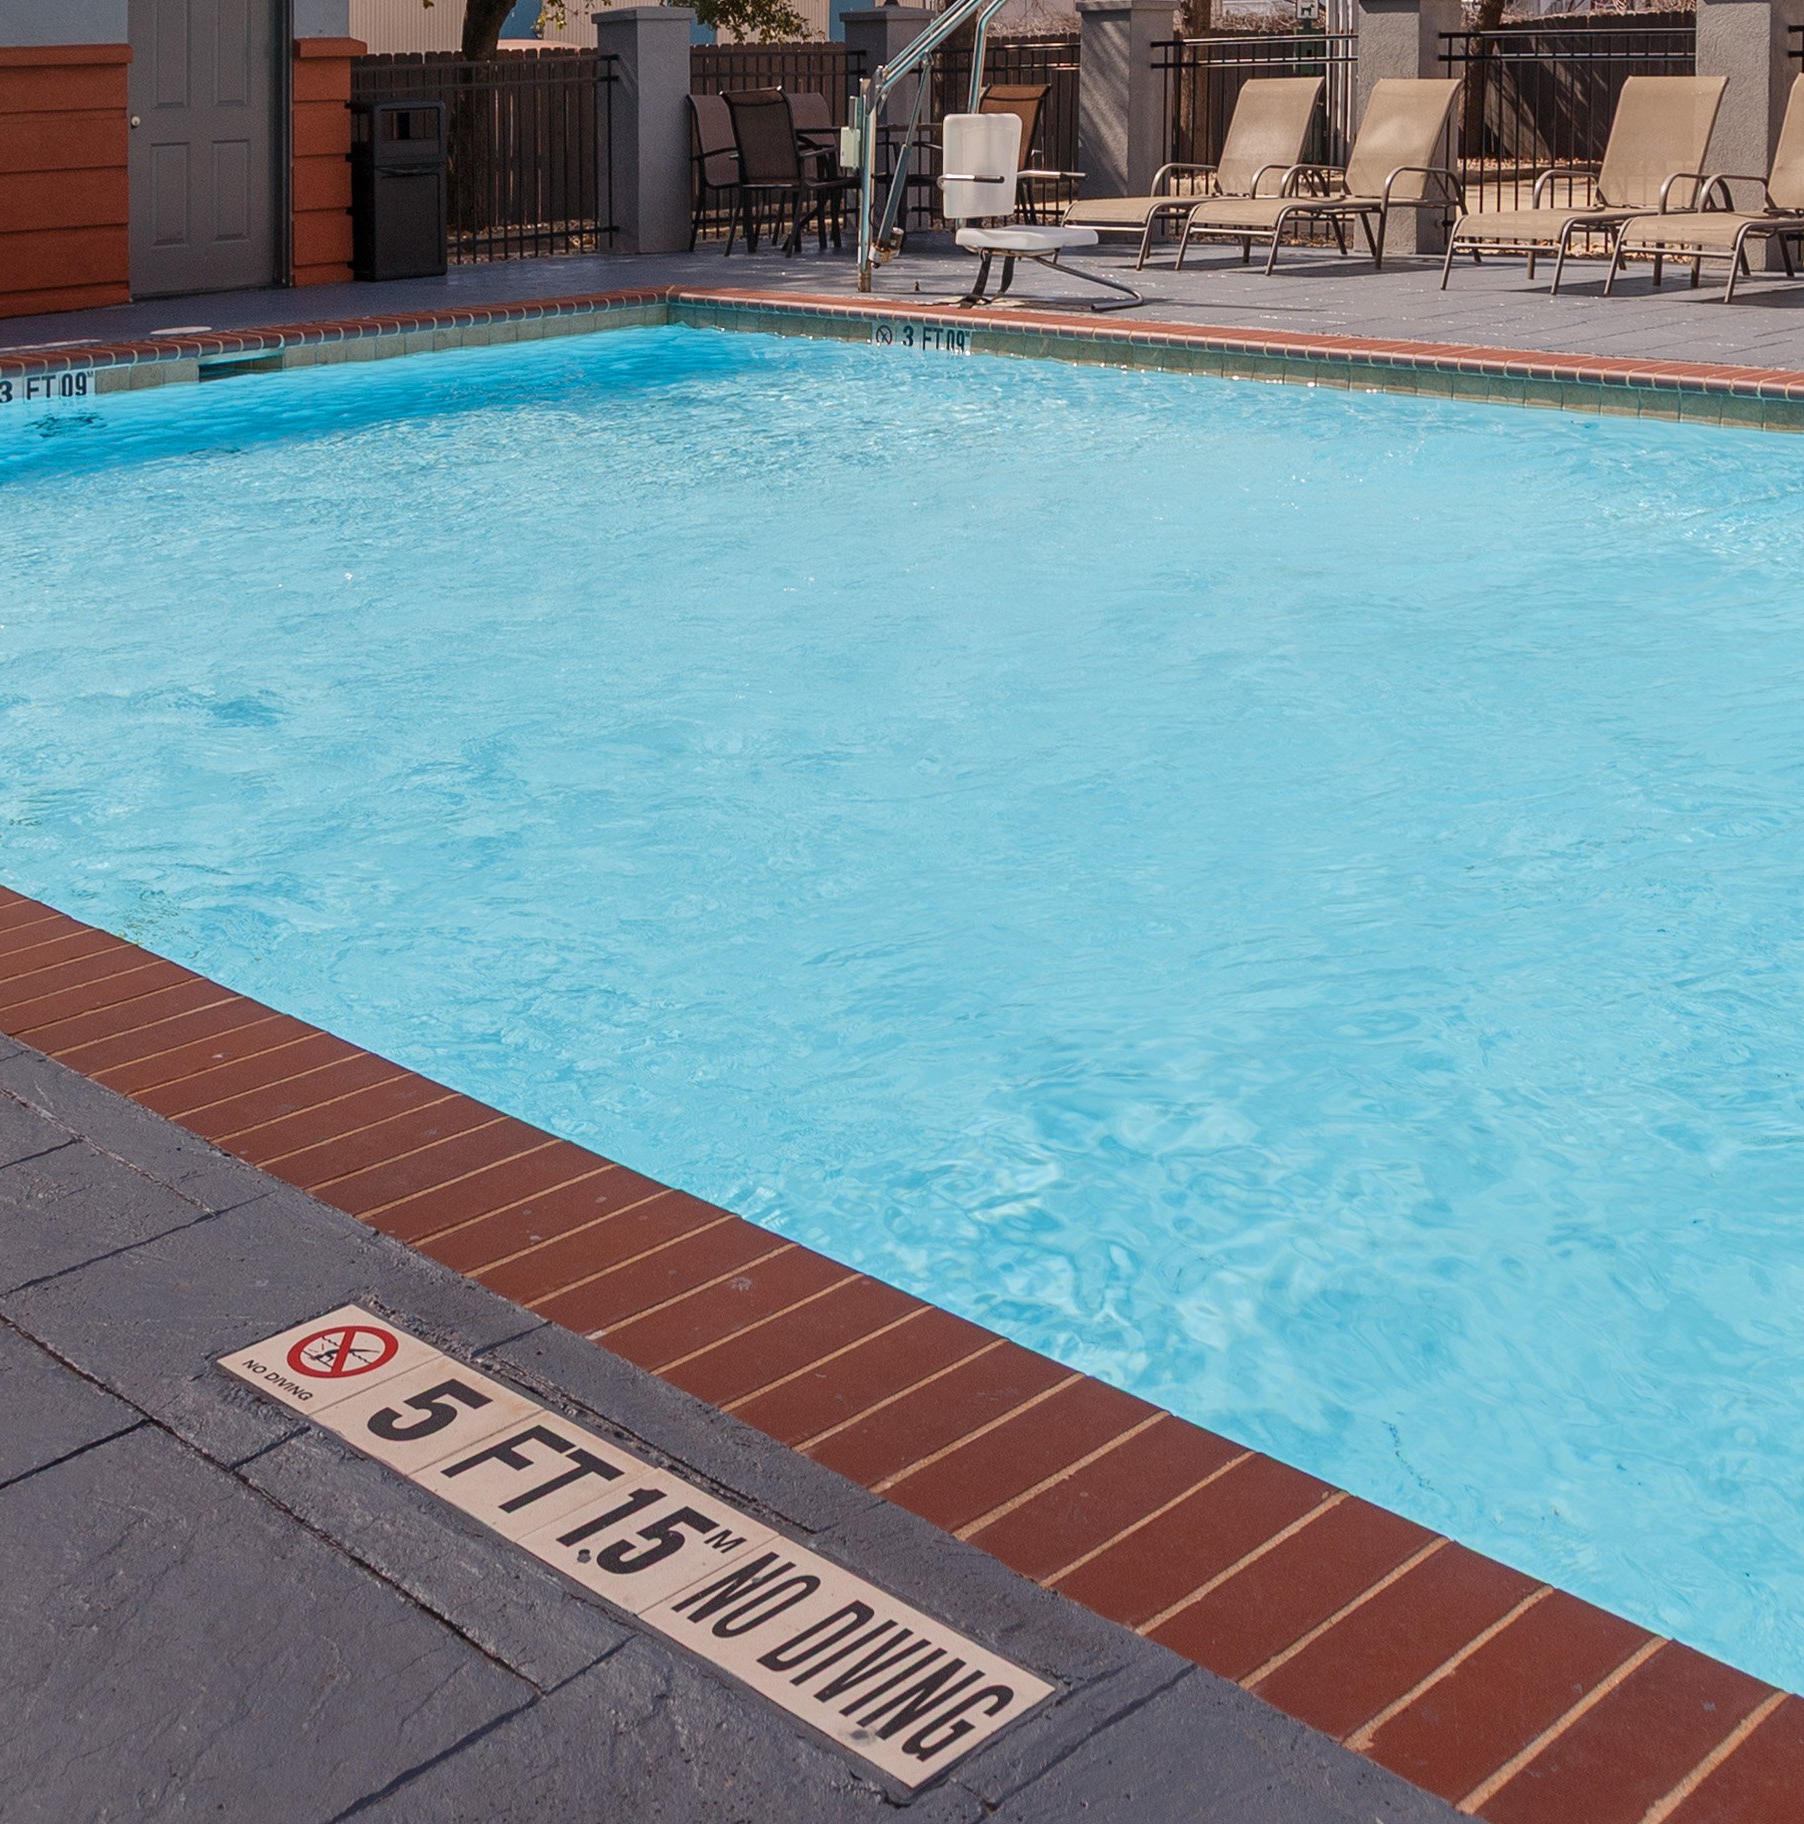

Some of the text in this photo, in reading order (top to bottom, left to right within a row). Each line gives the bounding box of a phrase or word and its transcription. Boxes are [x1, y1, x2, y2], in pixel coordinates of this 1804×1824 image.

[903, 326, 914, 347] 3
[923, 328, 944, 350] FT
[27, 375, 56, 400] FT
[242, 1359, 313, 1401] NO DIVING
[367, 1378, 493, 1441] 5
[440, 1425, 625, 1513] FT
[671, 1551, 821, 1638] NO
[756, 1599, 1014, 1762] DIVING
